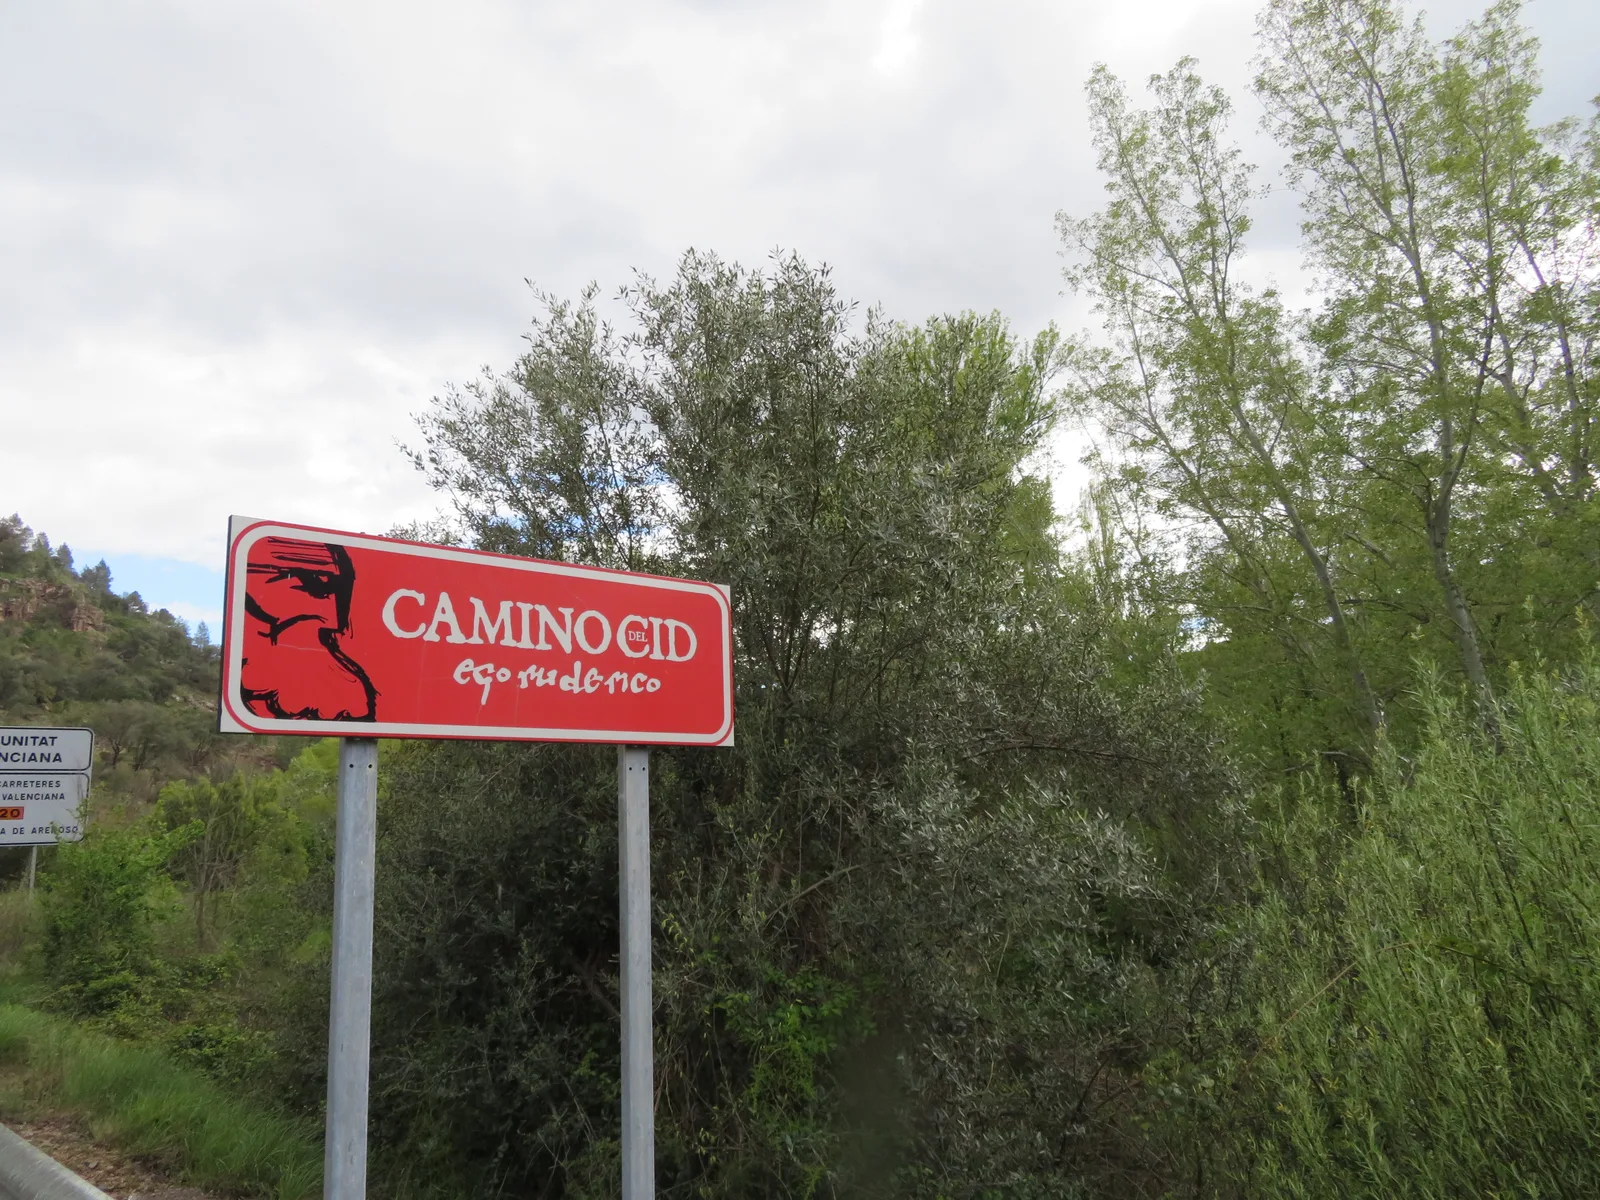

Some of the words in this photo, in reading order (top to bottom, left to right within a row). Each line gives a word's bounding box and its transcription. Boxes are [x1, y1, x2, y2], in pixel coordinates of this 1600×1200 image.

[382, 588, 611, 655] CAMINO
[617, 615, 697, 661] CID
[628, 631, 648, 643] DEL
[1, 736, 58, 746] UNITAT
[0, 780, 61, 788] ARRETERES
[2, 793, 65, 801] VALENCIANA
[12, 827, 25, 835] DE
